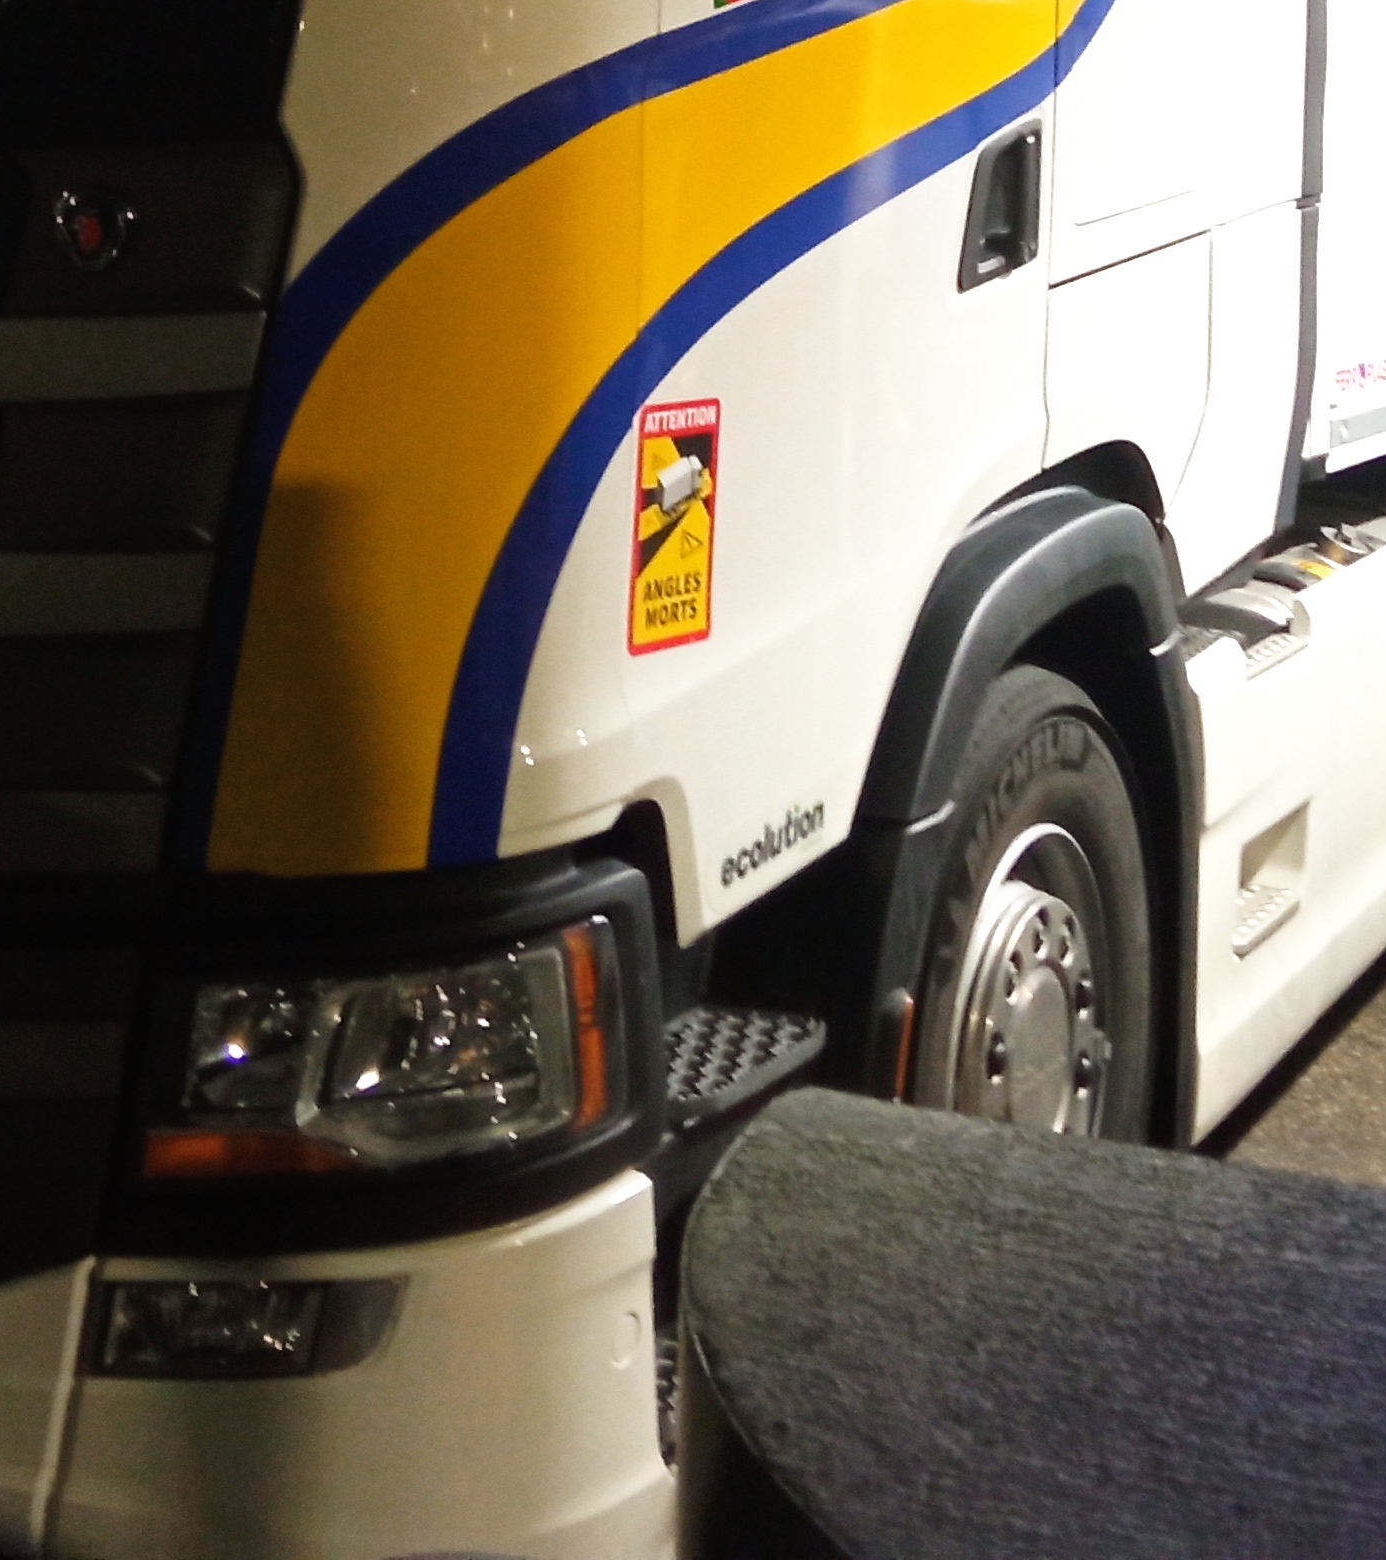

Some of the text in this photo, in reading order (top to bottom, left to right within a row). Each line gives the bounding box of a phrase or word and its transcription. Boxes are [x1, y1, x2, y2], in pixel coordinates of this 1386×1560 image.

[643, 404, 717, 434] ATTENTION
[642, 571, 702, 605] ANGLES
[644, 598, 697, 631] MORTS
[719, 801, 825, 888] ecolution
